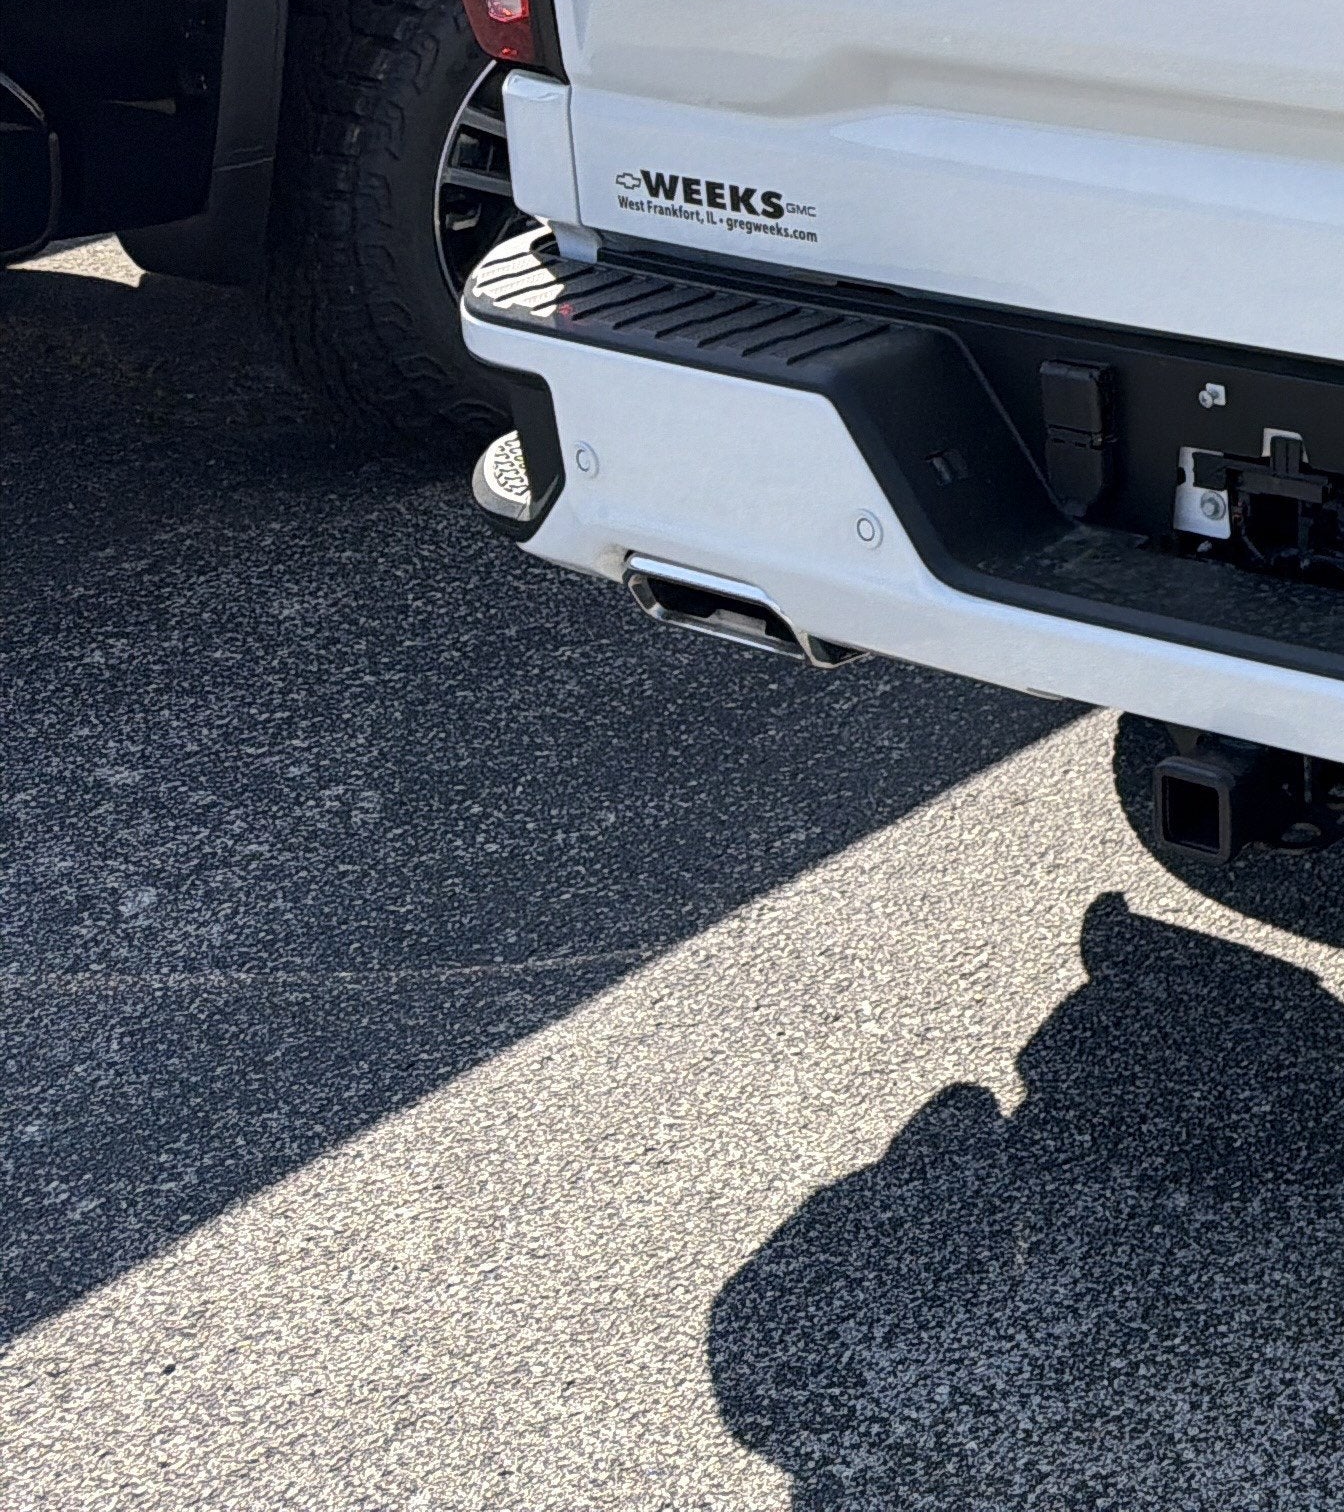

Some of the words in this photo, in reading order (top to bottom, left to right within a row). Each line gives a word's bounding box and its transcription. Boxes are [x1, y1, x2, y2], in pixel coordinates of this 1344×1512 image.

[617, 194, 645, 213] West
[647, 199, 704, 225] Frankfort,
[705, 210, 718, 226] IL
[726, 216, 818, 243] gregweeks.com
[639, 169, 785, 219] WEEKS
[785, 202, 817, 218] GMC
